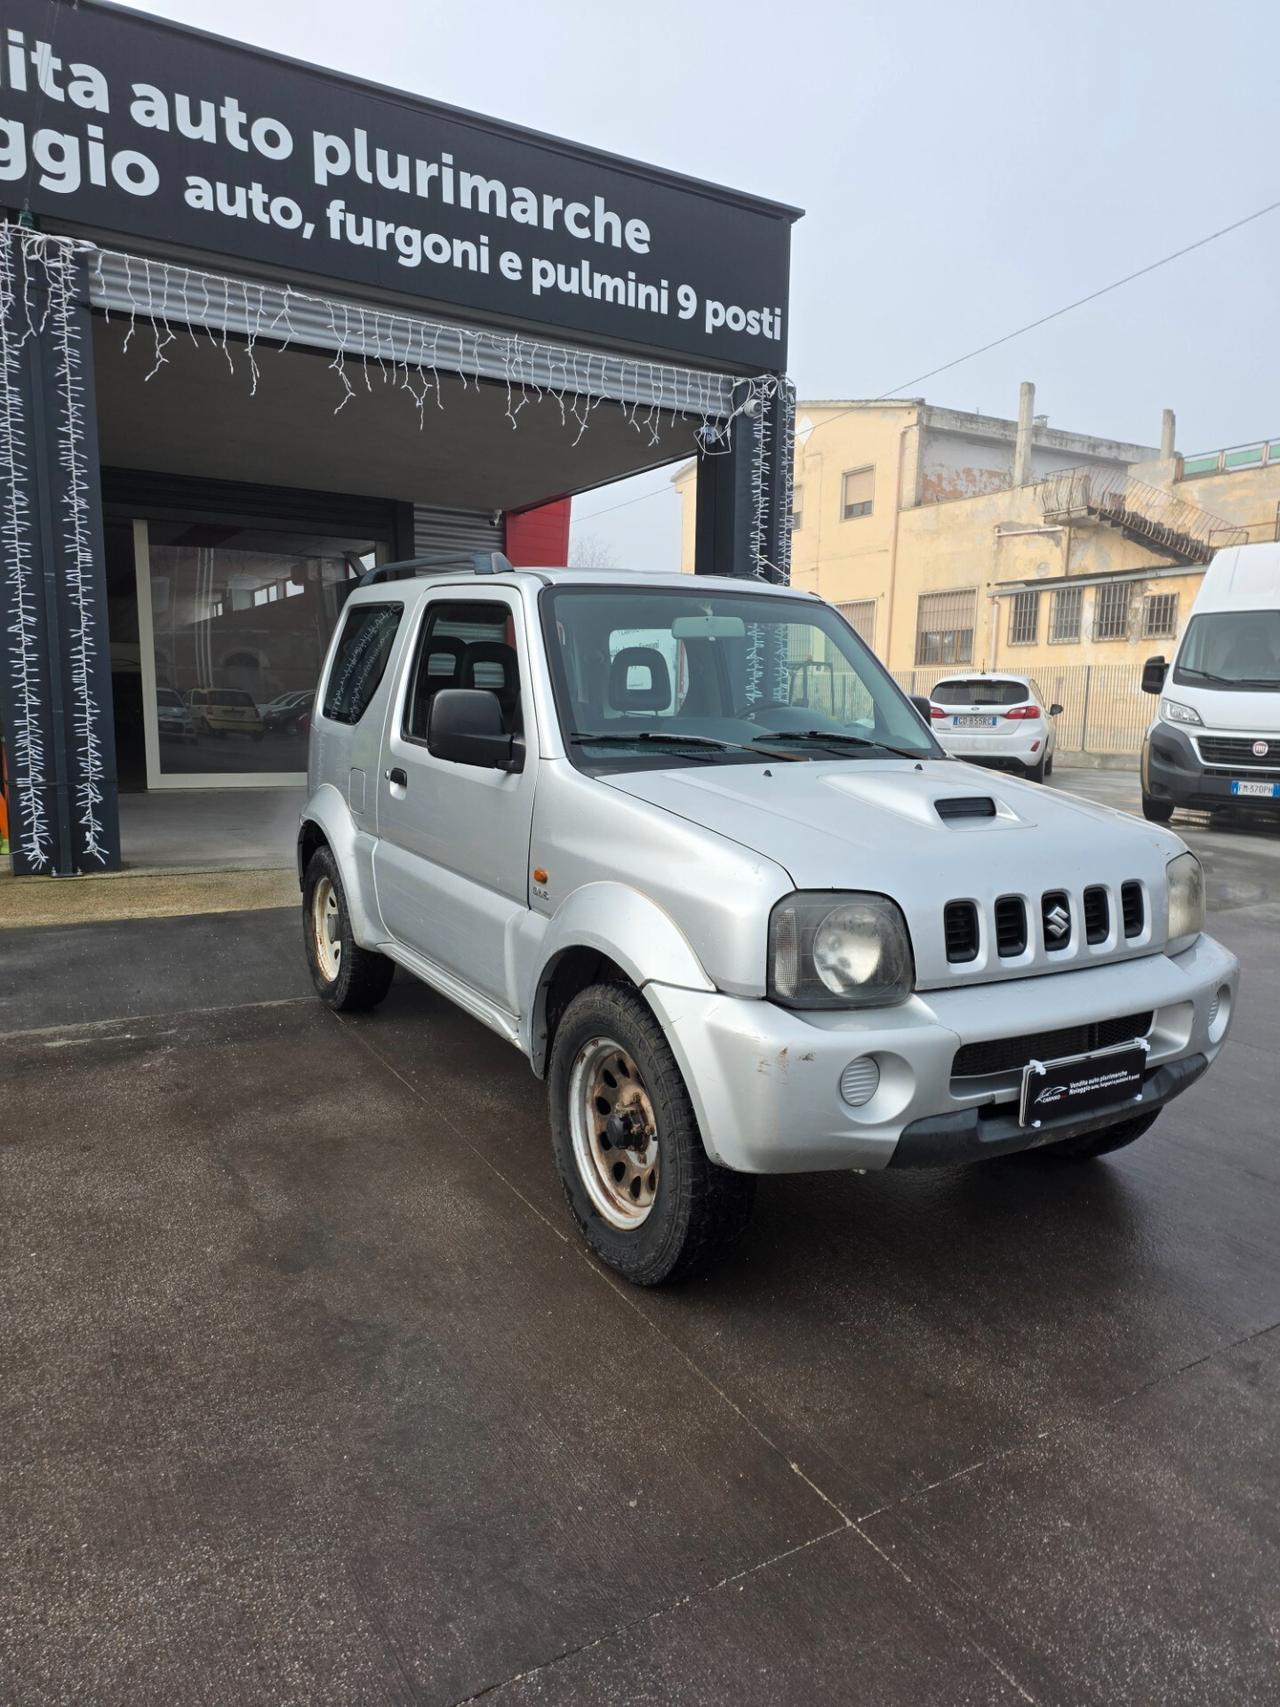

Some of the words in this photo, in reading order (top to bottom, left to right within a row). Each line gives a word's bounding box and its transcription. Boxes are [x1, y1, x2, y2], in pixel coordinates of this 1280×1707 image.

[0, 28, 110, 114] ita
[129, 83, 293, 161] auto
[312, 128, 651, 254] plurimarche
[184, 175, 316, 240] auto,
[325, 199, 489, 268] furgoni
[499, 251, 523, 281] e
[531, 257, 669, 315] pulmini
[676, 284, 698, 320] 9
[705, 299, 782, 341] posti
